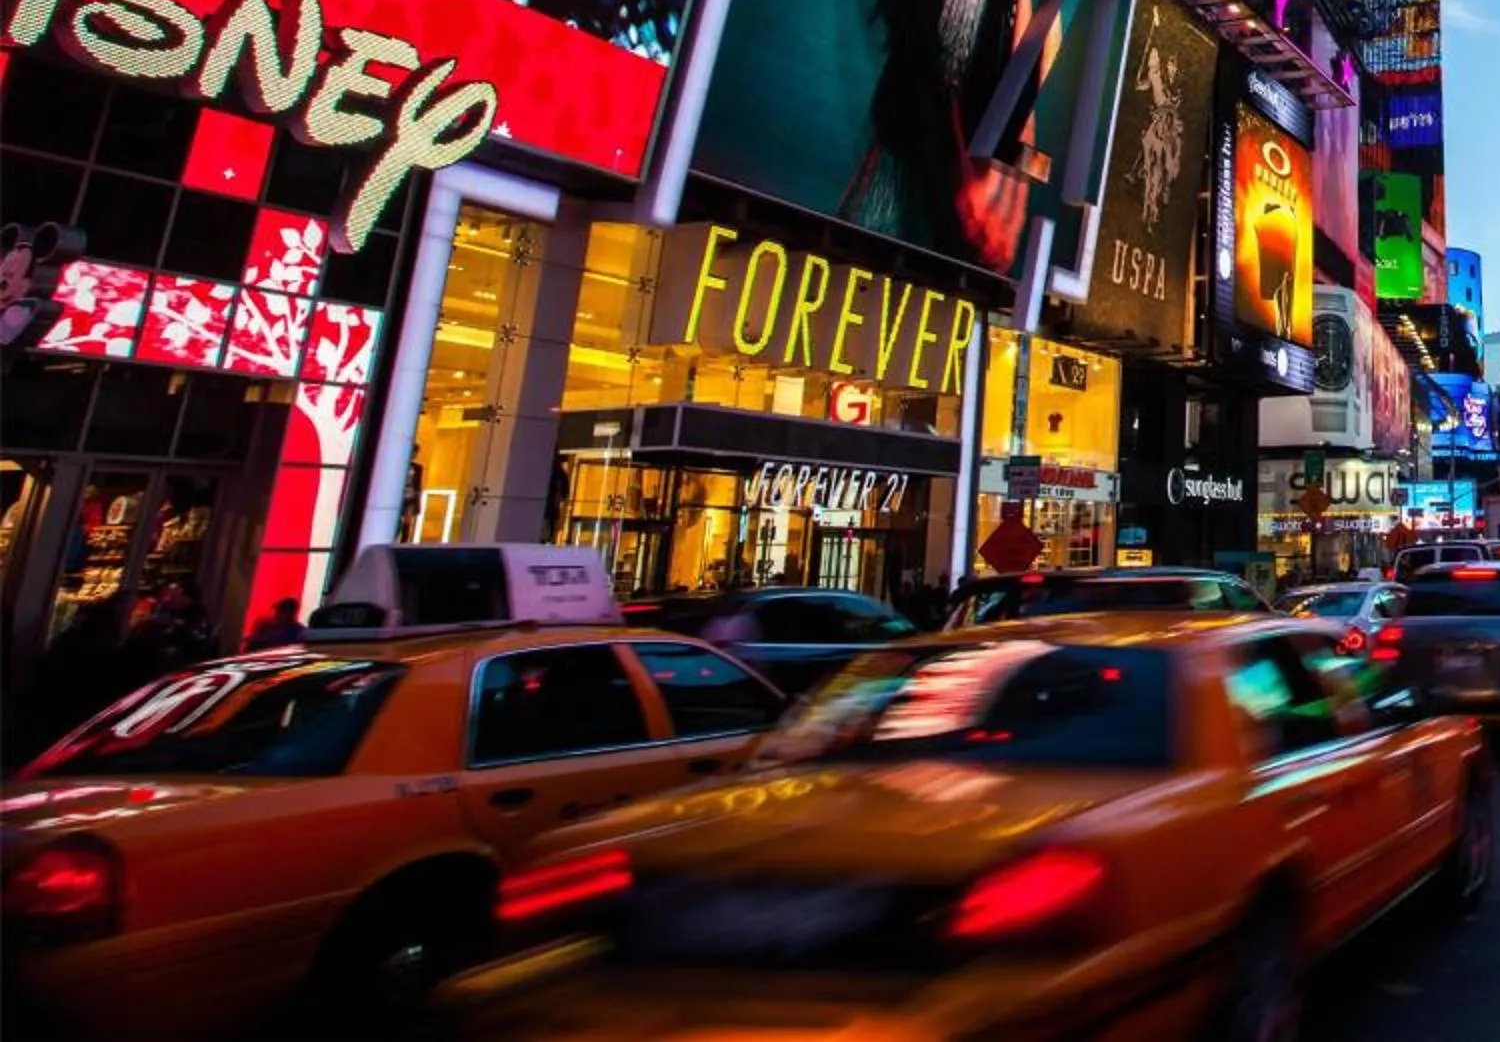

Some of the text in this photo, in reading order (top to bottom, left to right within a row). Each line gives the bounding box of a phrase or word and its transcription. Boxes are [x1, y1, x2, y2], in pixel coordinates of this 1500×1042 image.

[1111, 239, 1167, 302] USPA
[684, 224, 976, 396] FOREVER
[752, 460, 909, 513] FOREVER 21
